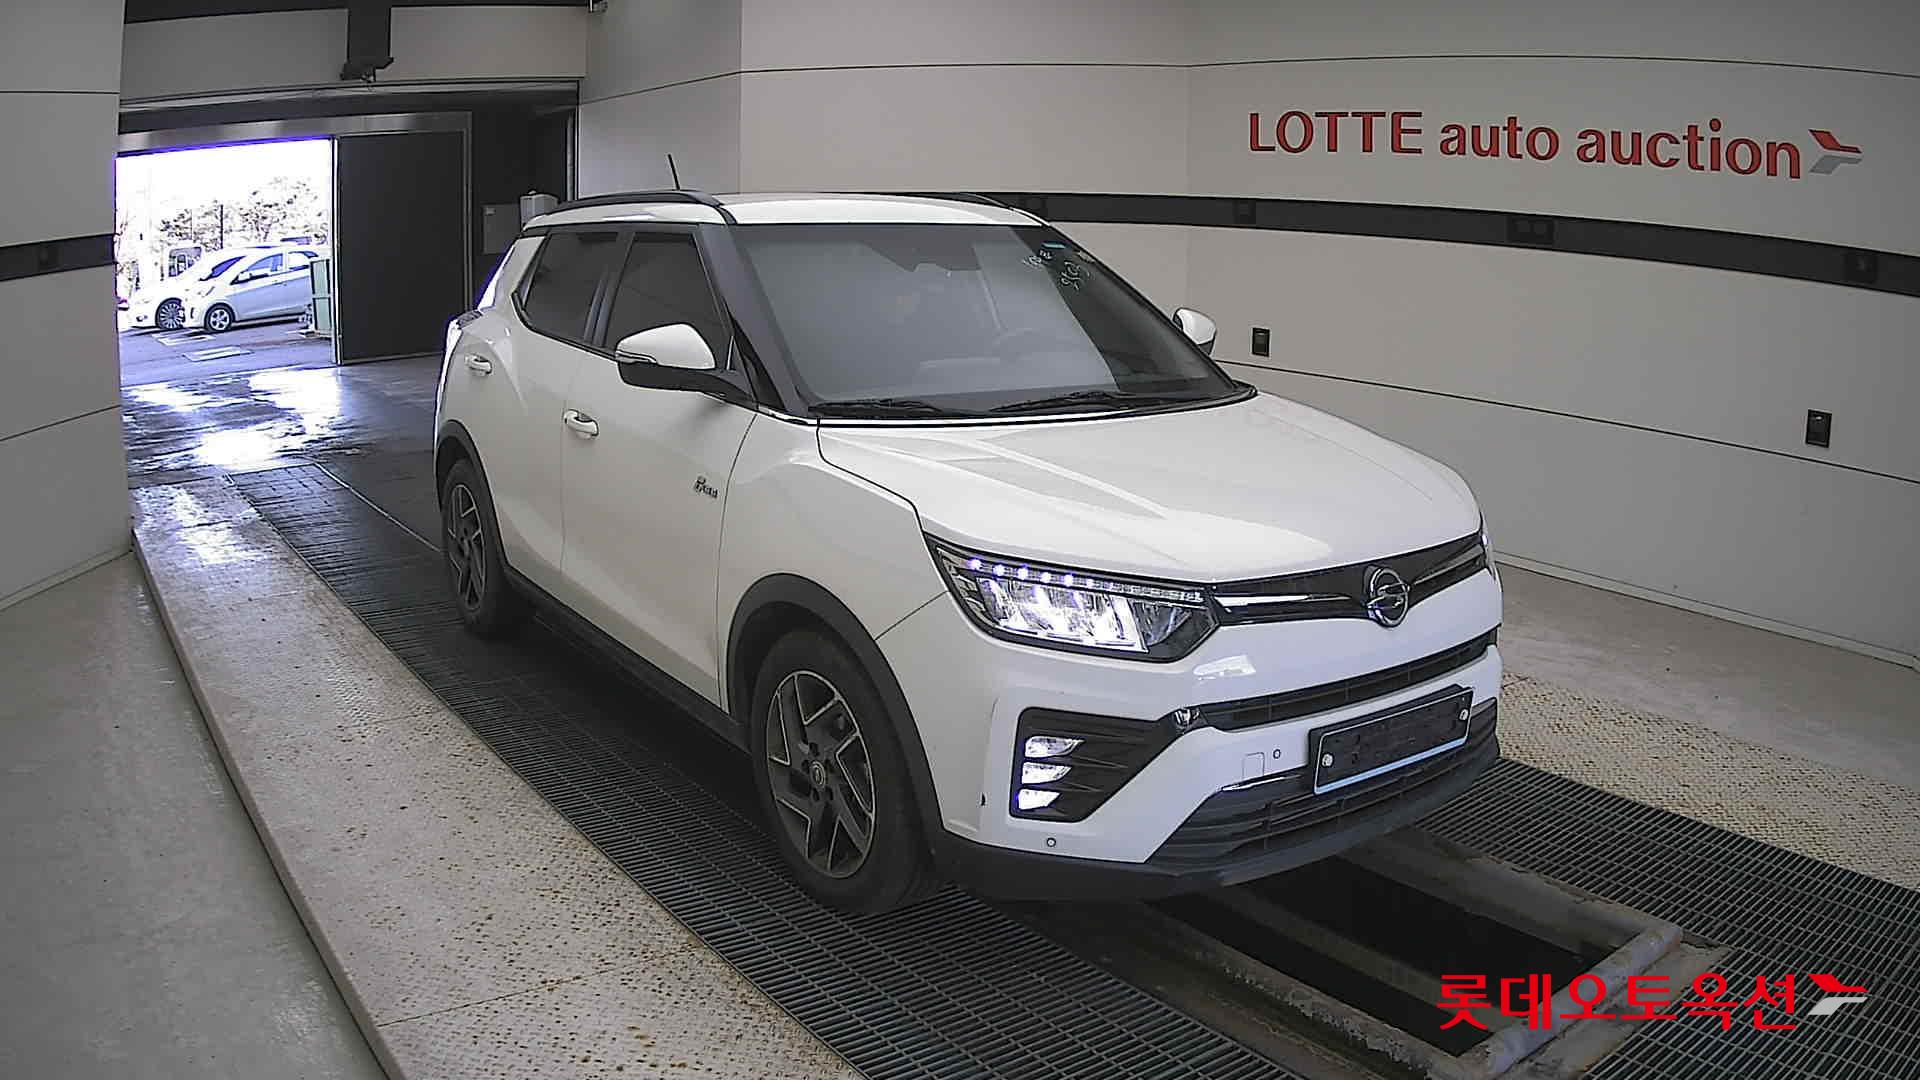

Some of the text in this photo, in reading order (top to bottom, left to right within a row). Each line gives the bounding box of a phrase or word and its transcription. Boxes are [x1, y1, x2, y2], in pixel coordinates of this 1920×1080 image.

[1249, 111, 1801, 179] LOTTE auto auction
